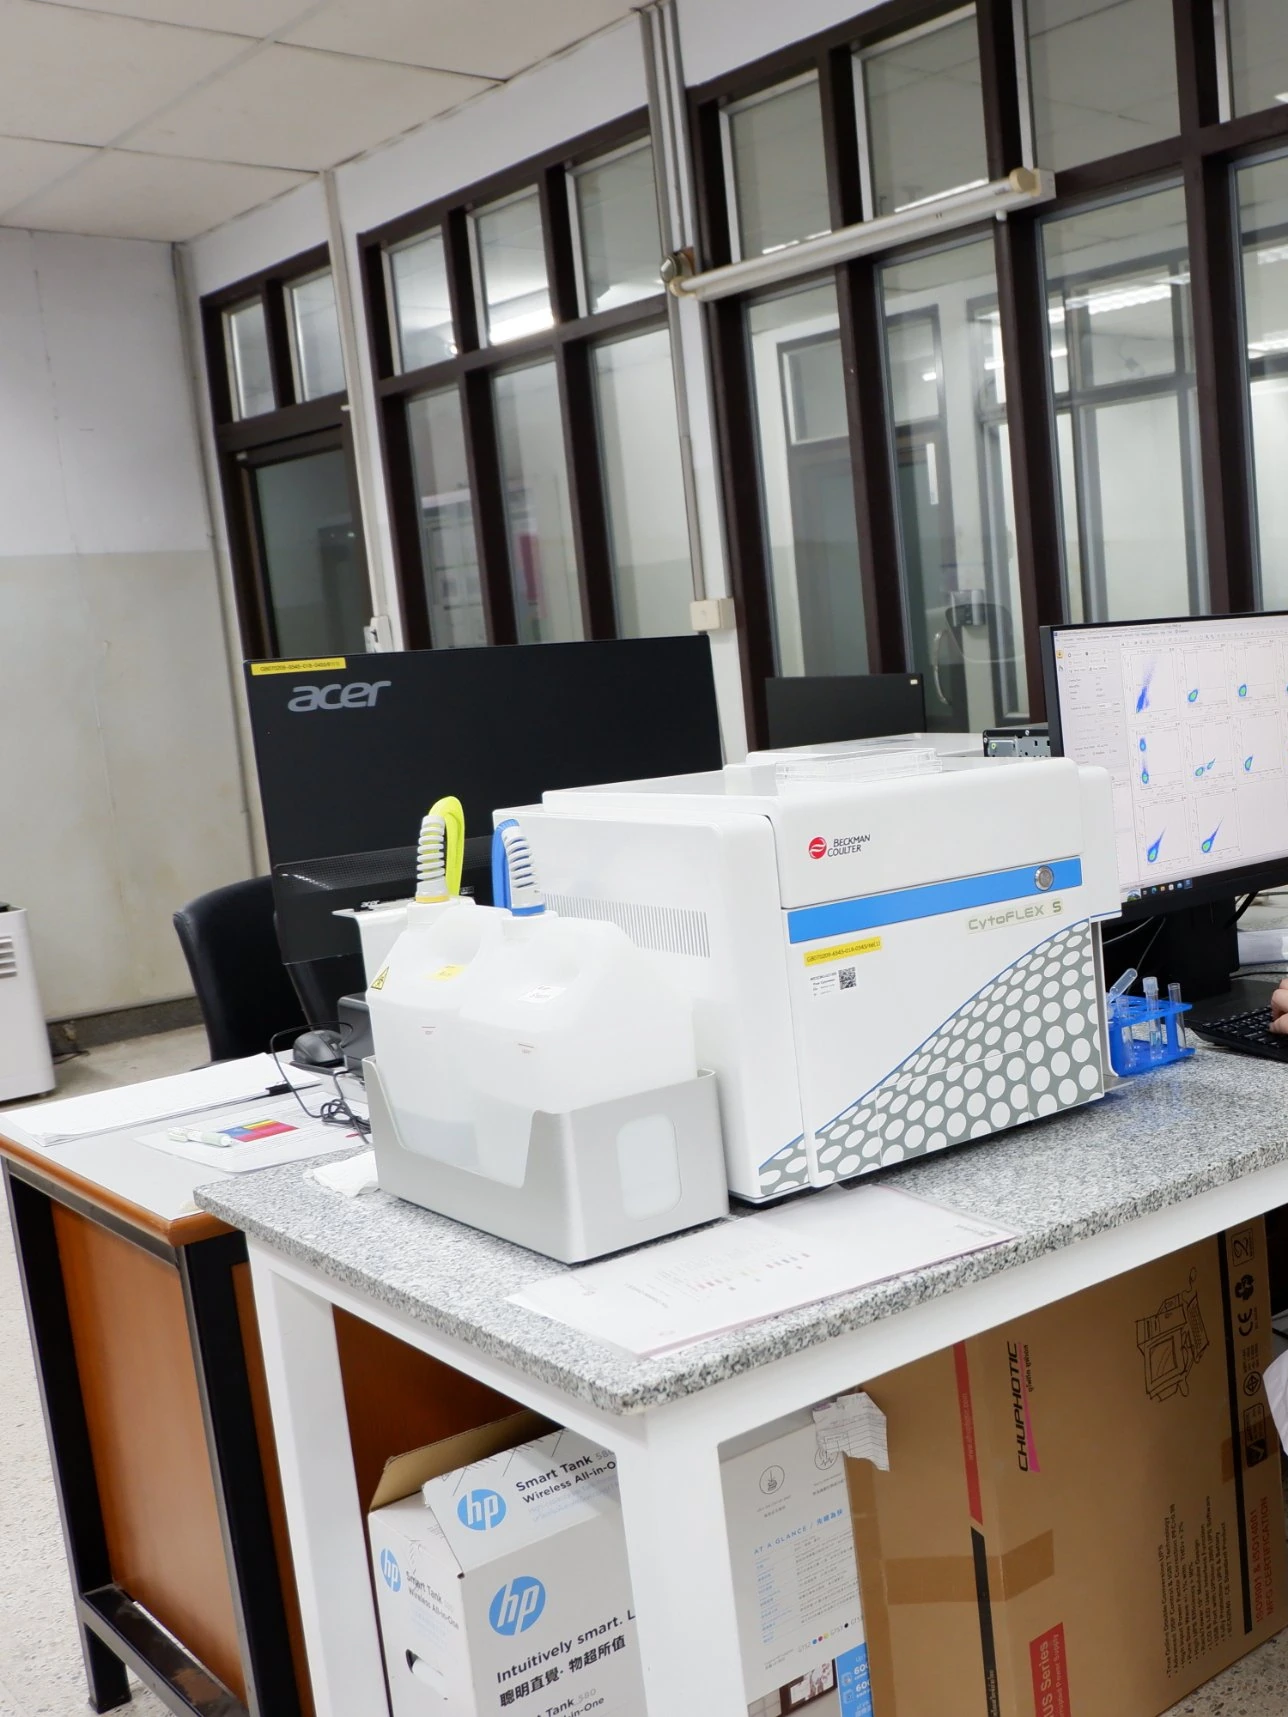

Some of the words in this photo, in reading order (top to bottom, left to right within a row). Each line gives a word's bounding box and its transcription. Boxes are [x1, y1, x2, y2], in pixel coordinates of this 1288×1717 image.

[288, 681, 392, 712] acer
[827, 844, 862, 858] COULTER
[833, 834, 871, 848] BECKMAN
[968, 905, 1045, 931] CytoFLEX
[1052, 901, 1062, 914] S
[1007, 1340, 1028, 1472] CHUPHOTIC
[515, 1469, 558, 1492] Smart
[560, 1455, 593, 1475] Tank
[522, 1480, 572, 1504] Wireless
[575, 1461, 616, 1484] All-in-O
[463, 1489, 501, 1531] hp
[774, 1525, 807, 1546] GLANCE
[1250, 1509, 1260, 1562] ISO14001
[1260, 1496, 1272, 1587] CERTIFICATION
[383, 1548, 400, 1592] hp
[405, 1570, 426, 1592] Smart
[427, 1583, 443, 1604] Tank
[408, 1587, 431, 1610] Wireless
[432, 1603, 459, 1630] All-in-One
[495, 1577, 542, 1636] hp
[1254, 1576, 1264, 1623] ISO9001
[1266, 1590, 1274, 1616] MFG
[497, 1639, 572, 1683] Intuitively
[577, 1616, 623, 1645] smart.
[627, 1609, 636, 1620] L
[1039, 1641, 1051, 1691] Series
[545, 1698, 575, 1717] Tank
[578, 1687, 597, 1703] 580
